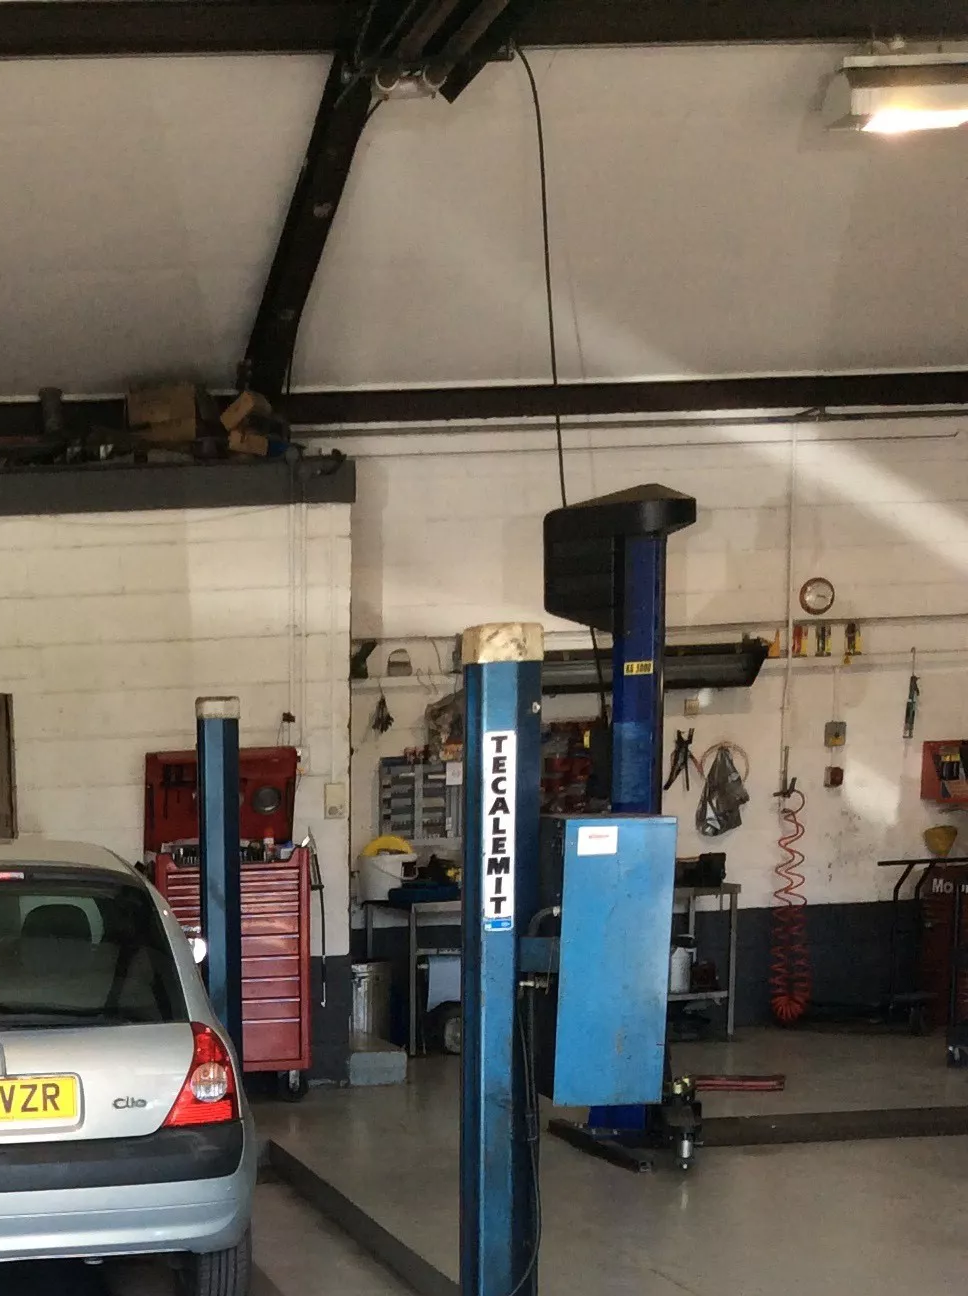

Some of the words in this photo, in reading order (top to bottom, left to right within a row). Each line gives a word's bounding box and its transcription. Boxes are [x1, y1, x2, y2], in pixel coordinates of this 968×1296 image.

[487, 736, 511, 914] TECALEMIT
[0, 1082, 60, 1114] VZR
[112, 1096, 147, 1109] Clio
